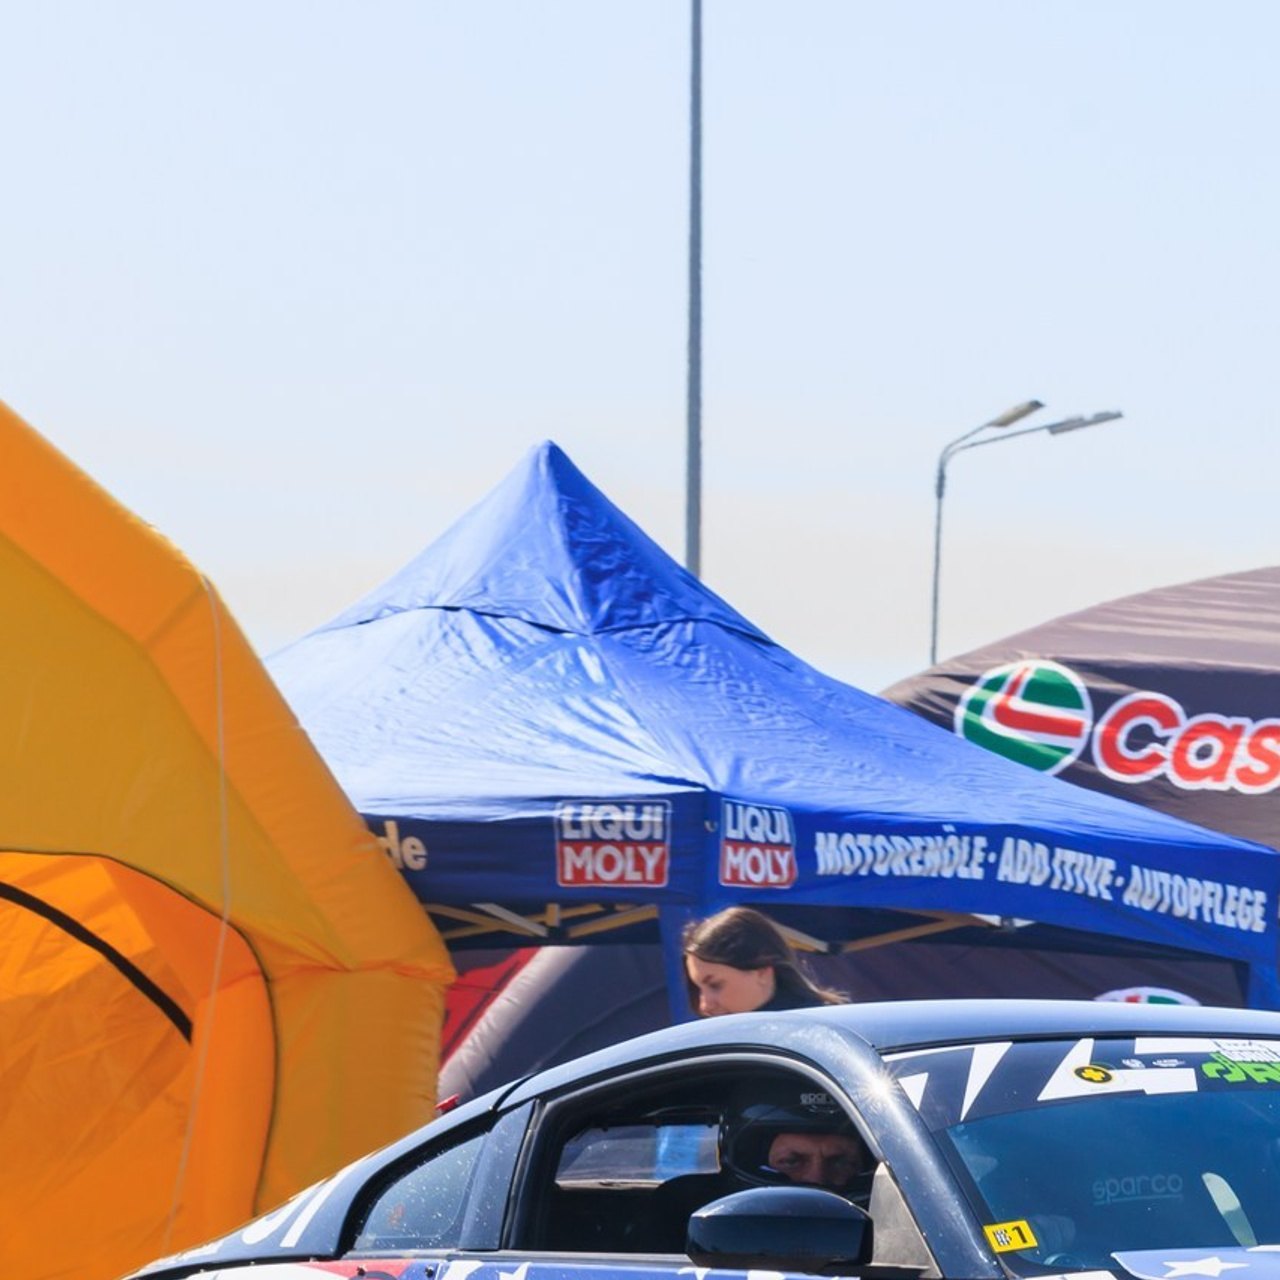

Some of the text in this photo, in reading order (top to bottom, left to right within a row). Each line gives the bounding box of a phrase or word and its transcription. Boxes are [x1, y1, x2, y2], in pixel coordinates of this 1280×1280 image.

[560, 802, 665, 840] LIQUI
[724, 803, 791, 843] LIQUI
[562, 843, 664, 881] MOLY
[723, 844, 792, 882] MOLY
[1122, 866, 1269, 934] AUTOPFLEGE
[1093, 1174, 1183, 1204] sparco
